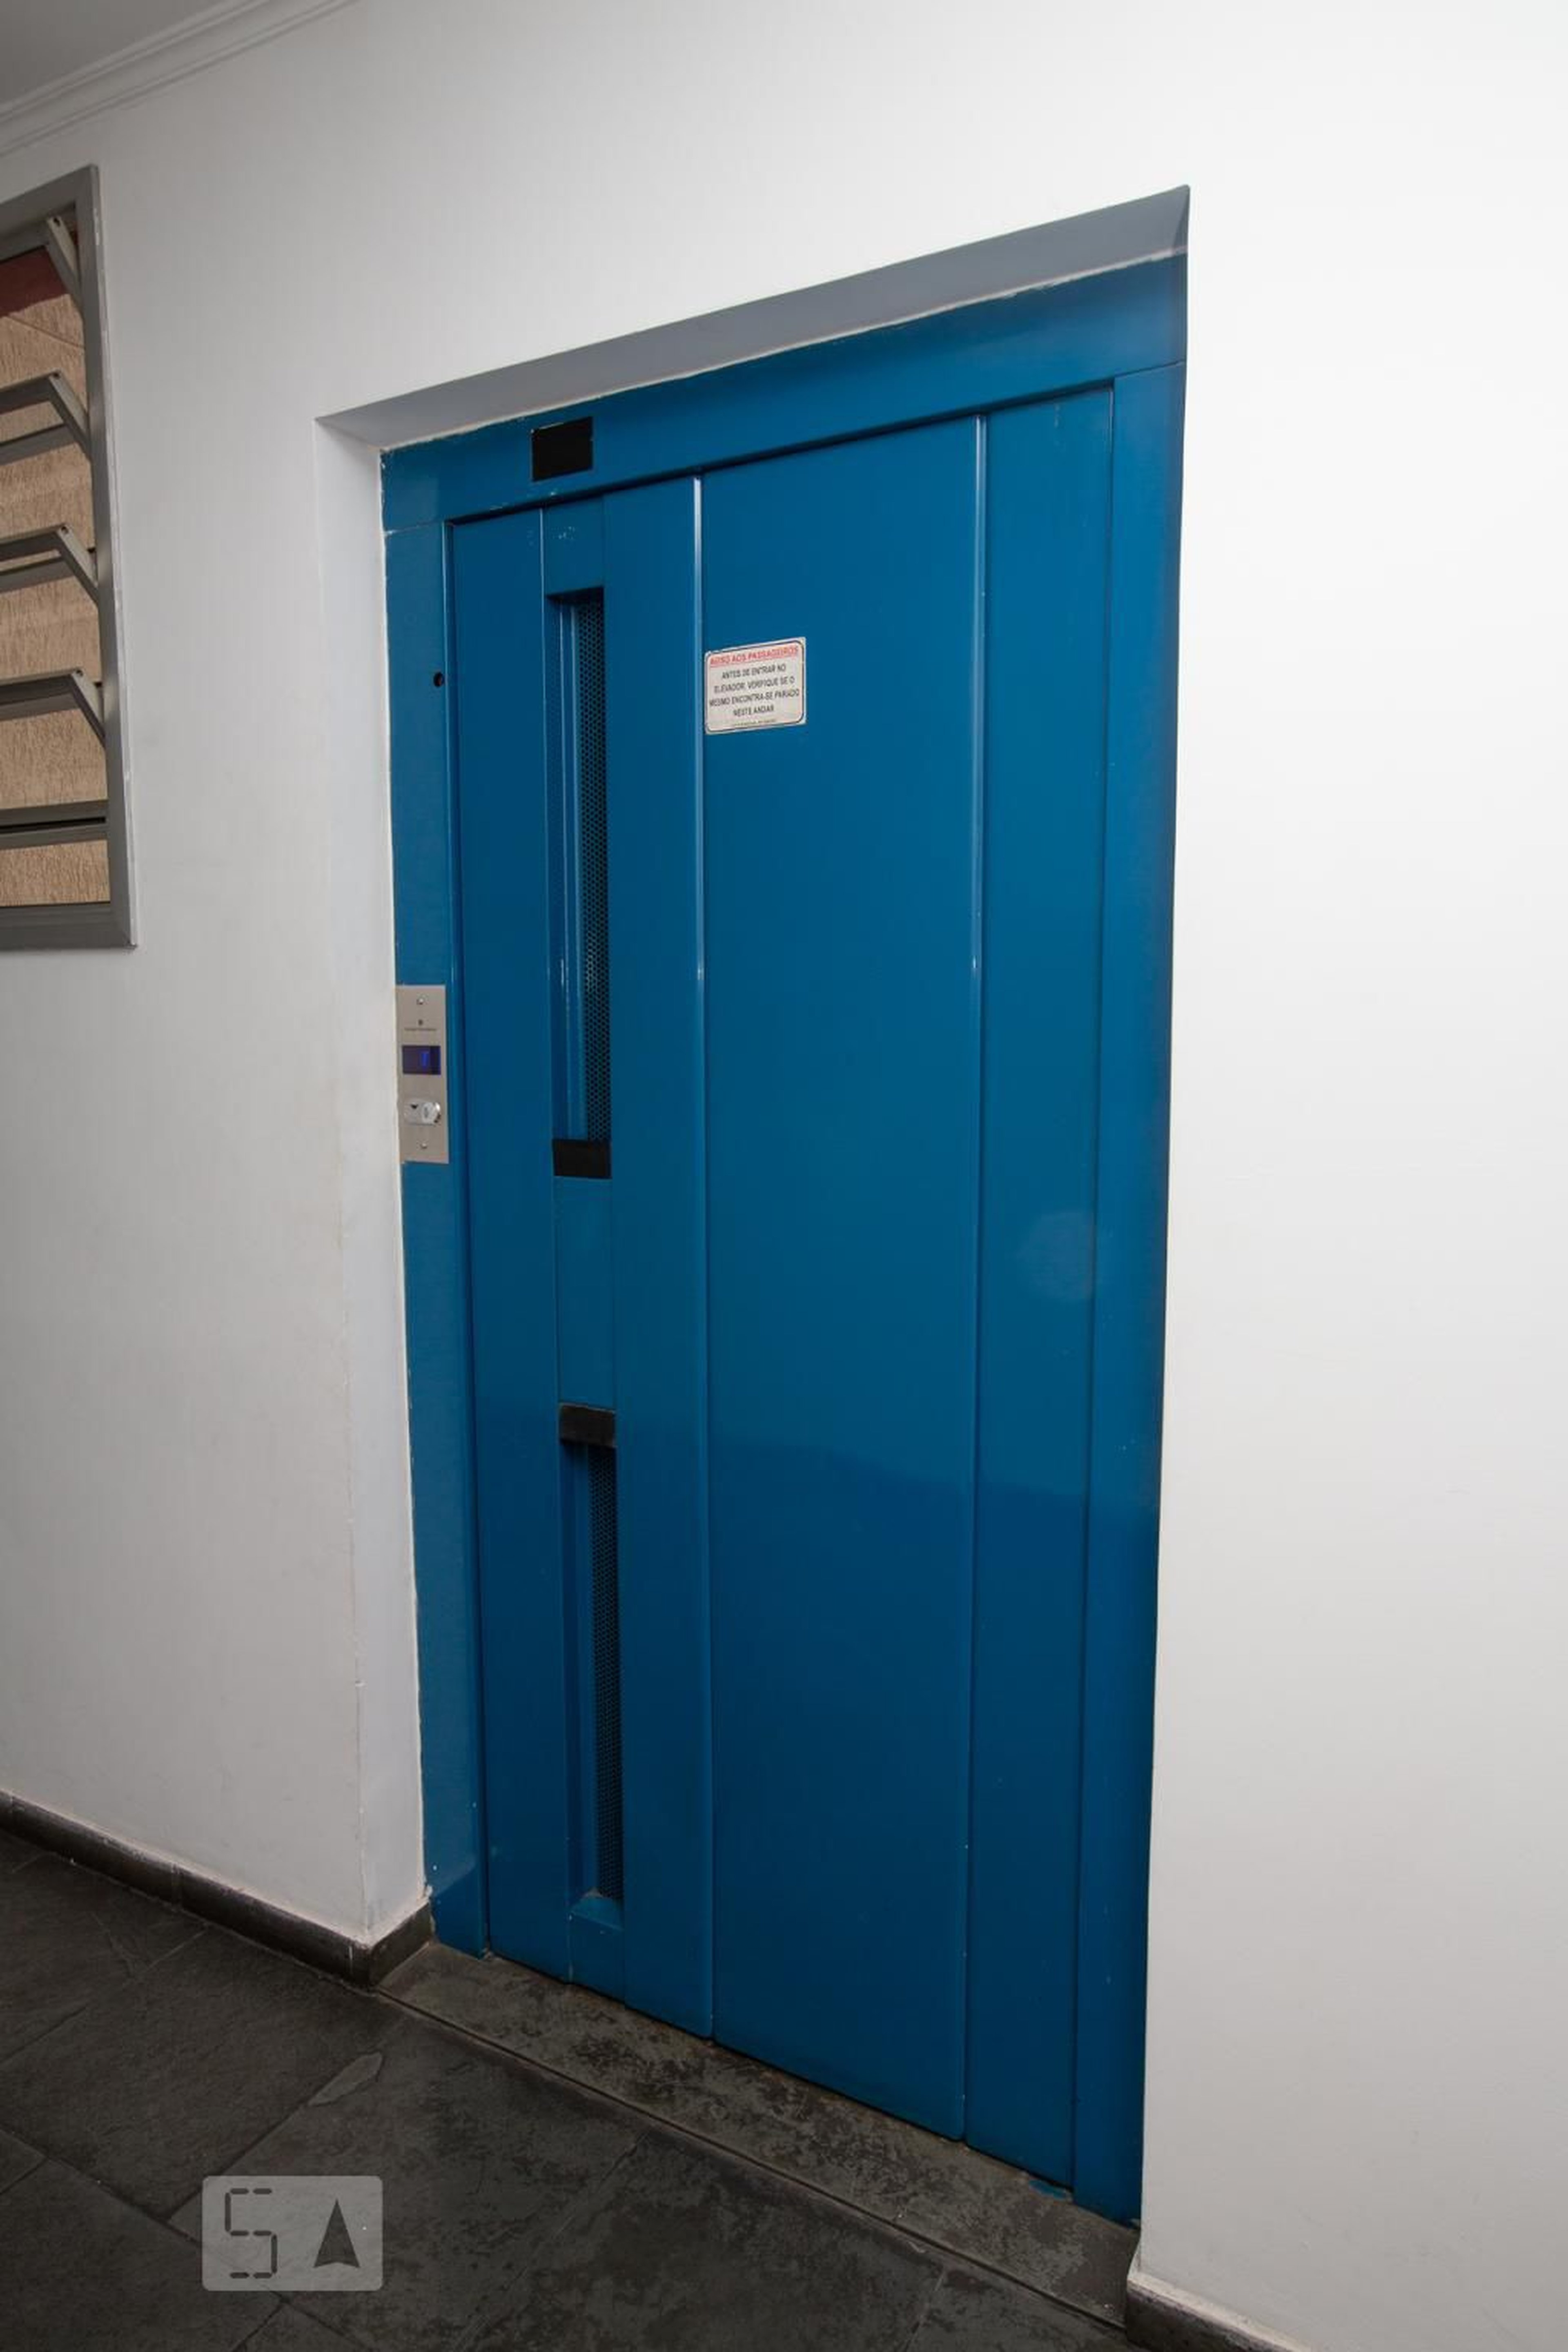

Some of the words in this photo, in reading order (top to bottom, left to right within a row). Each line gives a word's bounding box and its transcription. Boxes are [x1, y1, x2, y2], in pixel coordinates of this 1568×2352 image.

[710, 655, 730, 664] AVISO
[732, 653, 746, 662] AOS
[748, 646, 798, 659] PASSAGEIROS
[722, 670, 741, 679] ANTES
[752, 665, 775, 676] ENTRAR
[777, 664, 786, 672] NO
[748, 678, 778, 689] VERIFIQUE
[780, 677, 788, 685] SE
[789, 676, 795, 684] O
[710, 697, 730, 706] MESMO
[775, 688, 799, 698] PARADO
[733, 707, 751, 717] NESTE
